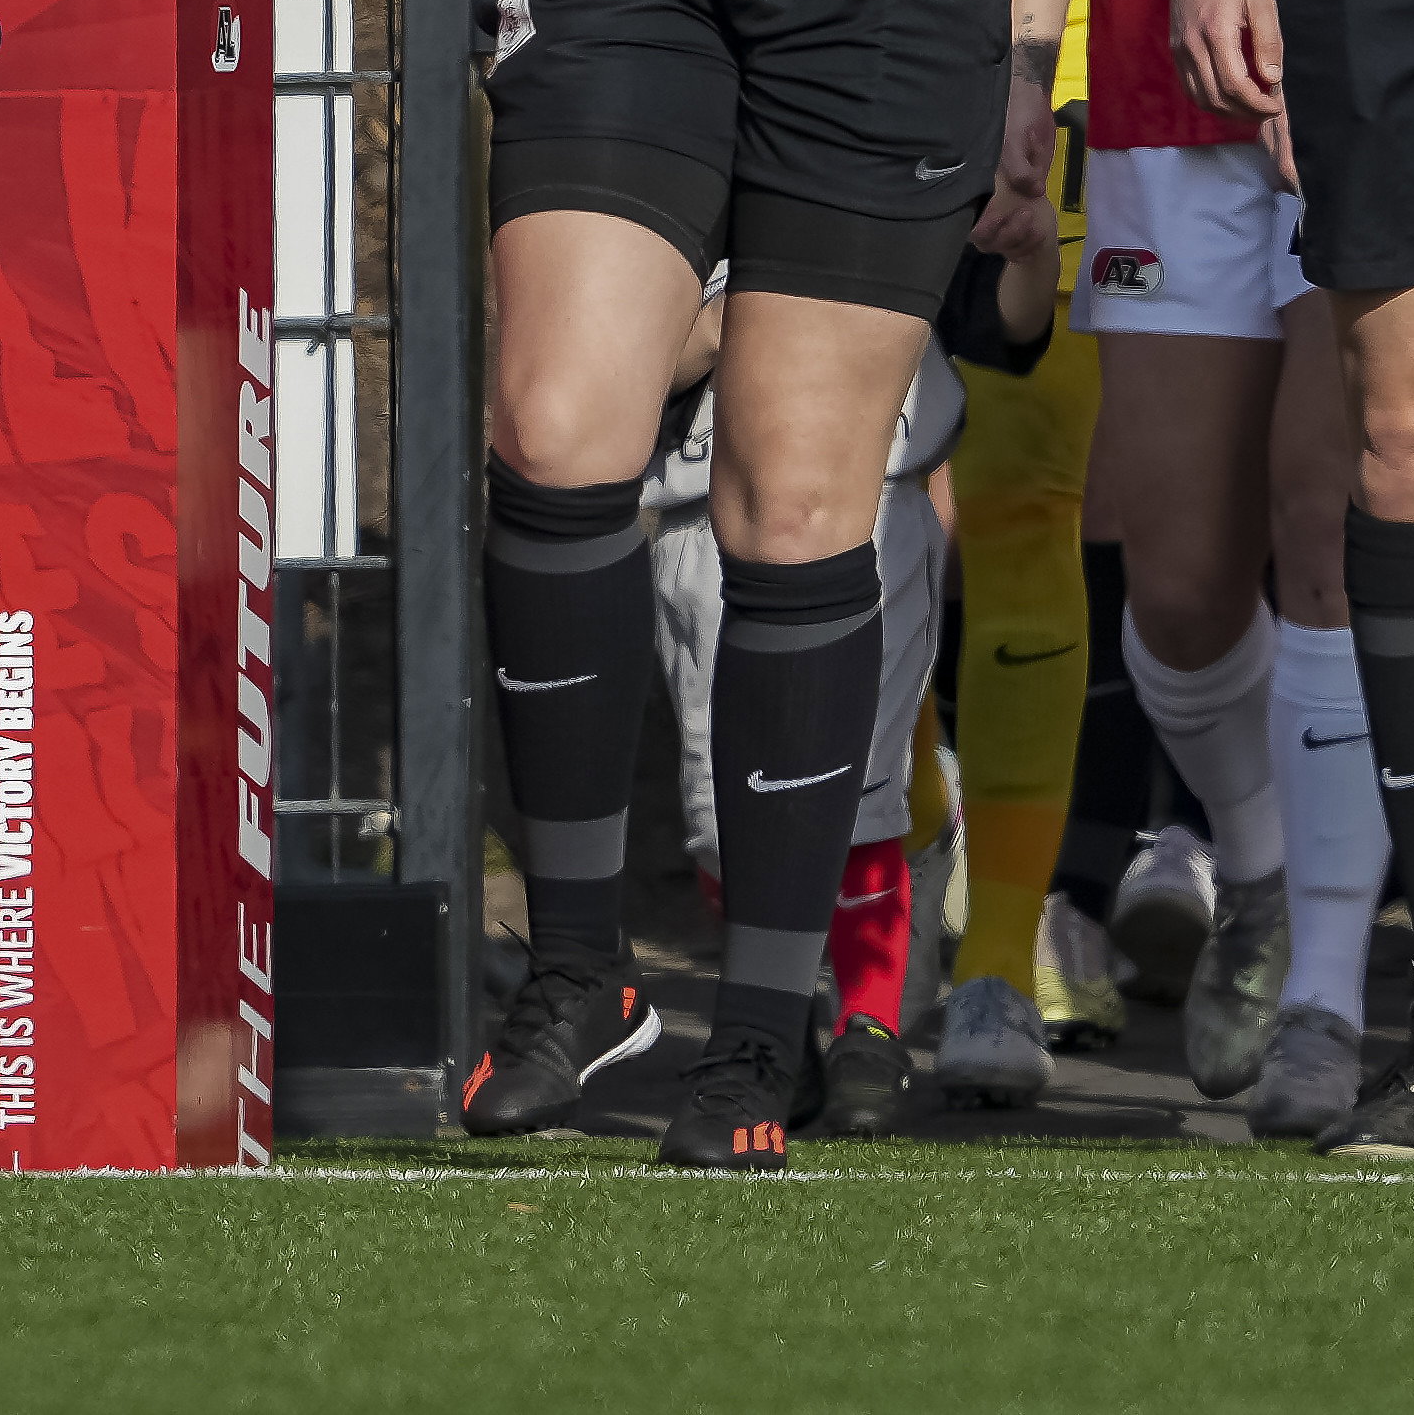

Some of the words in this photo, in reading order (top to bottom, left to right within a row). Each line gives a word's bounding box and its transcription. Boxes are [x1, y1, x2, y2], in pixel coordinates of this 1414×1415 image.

[1098, 255, 1149, 290] AZ
[237, 286, 273, 881] FUTURE
[237, 901, 273, 1167] THE
